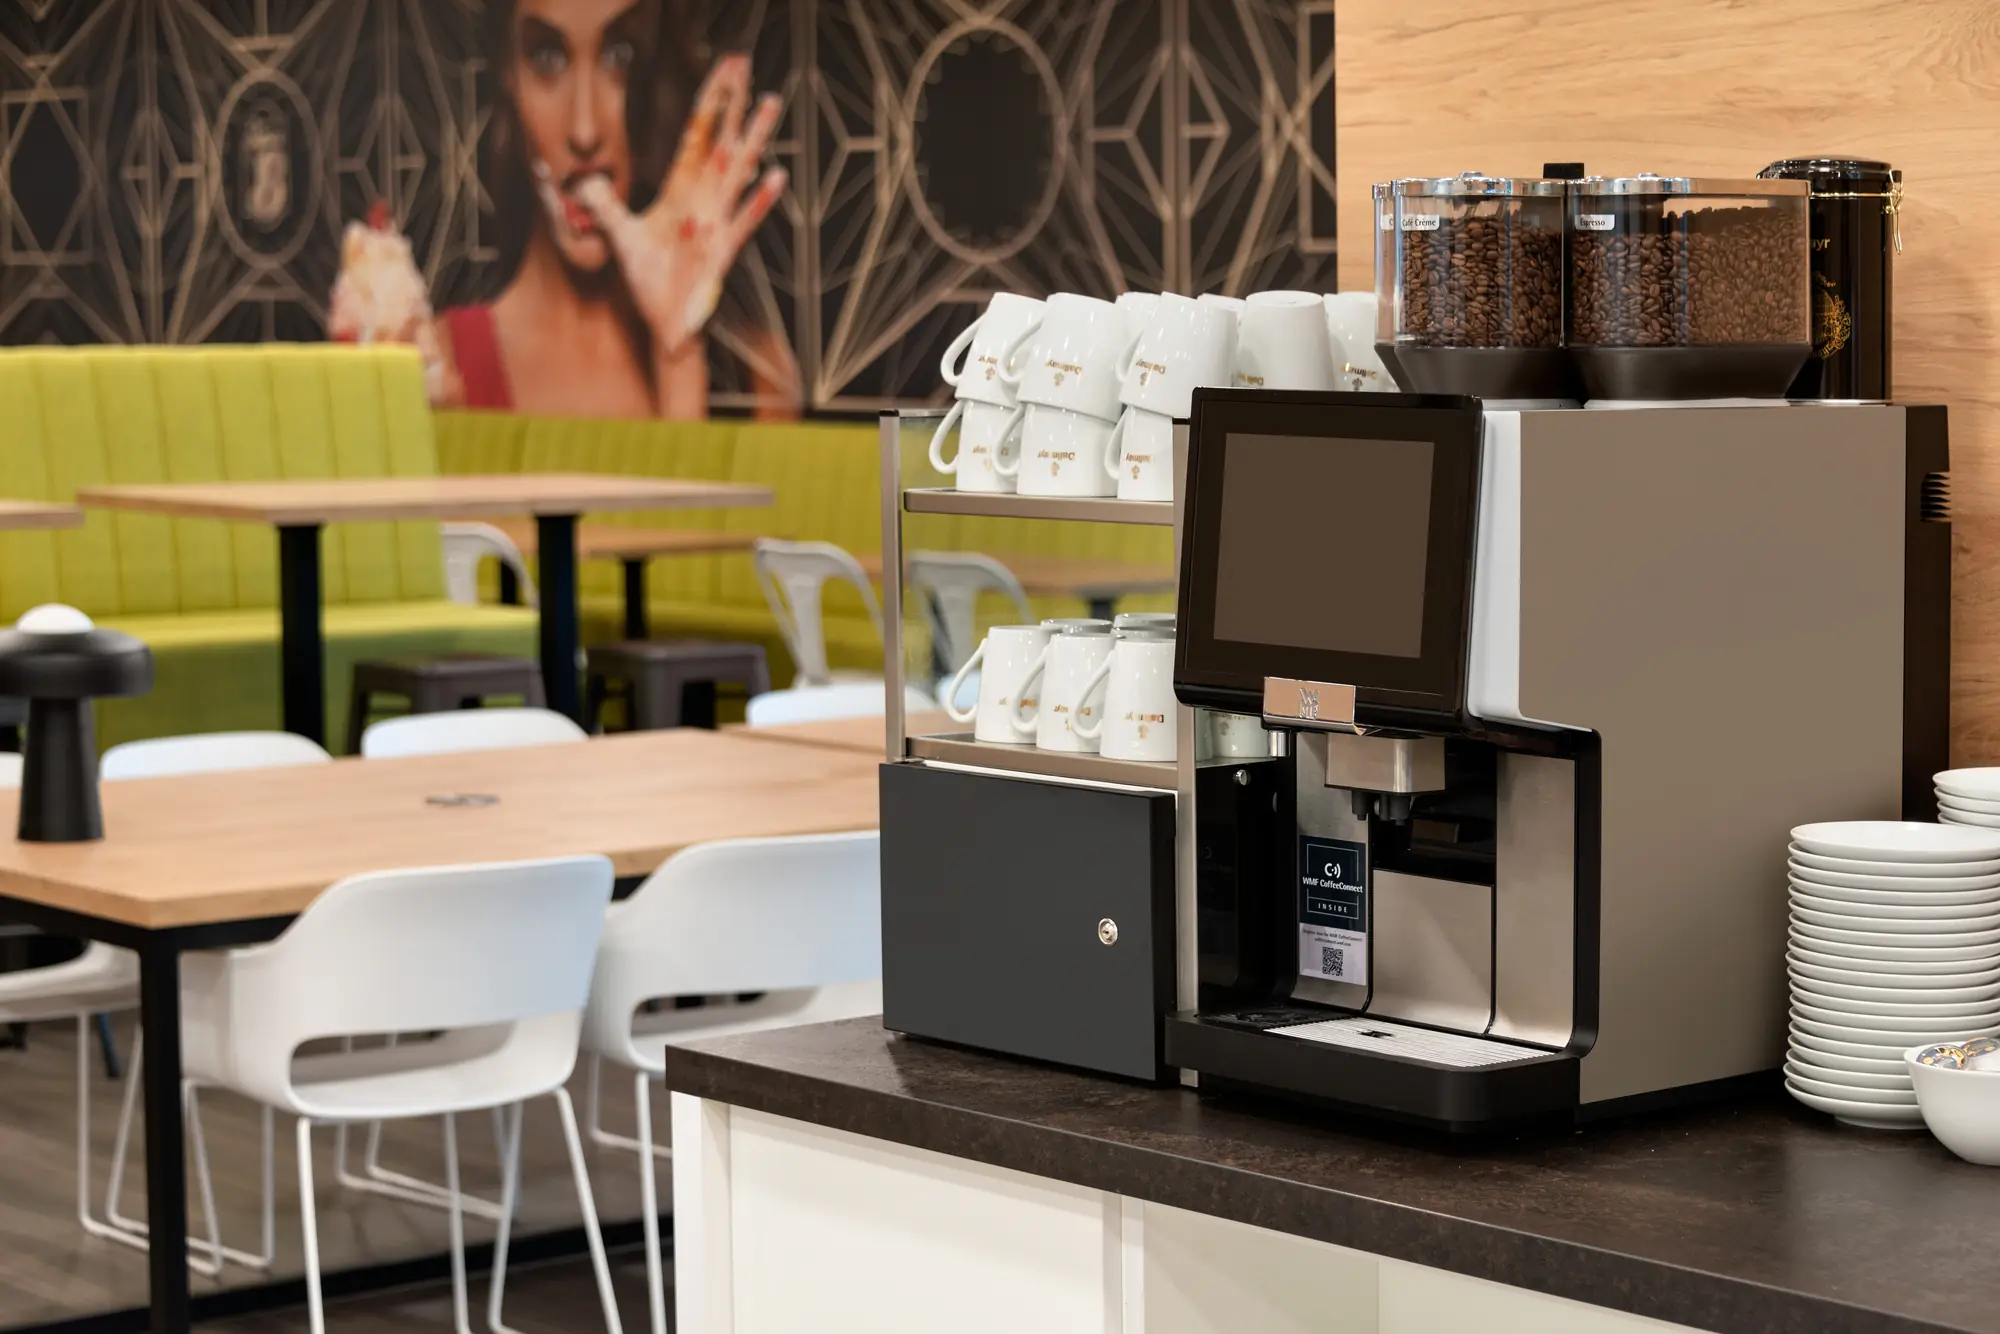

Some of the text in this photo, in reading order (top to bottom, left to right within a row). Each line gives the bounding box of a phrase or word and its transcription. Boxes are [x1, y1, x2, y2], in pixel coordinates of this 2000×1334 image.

[1580, 218, 1606, 228] Espresso
[1302, 876, 1363, 893] WMF CoffeeConnect
[1318, 902, 1348, 913] INSIDE
